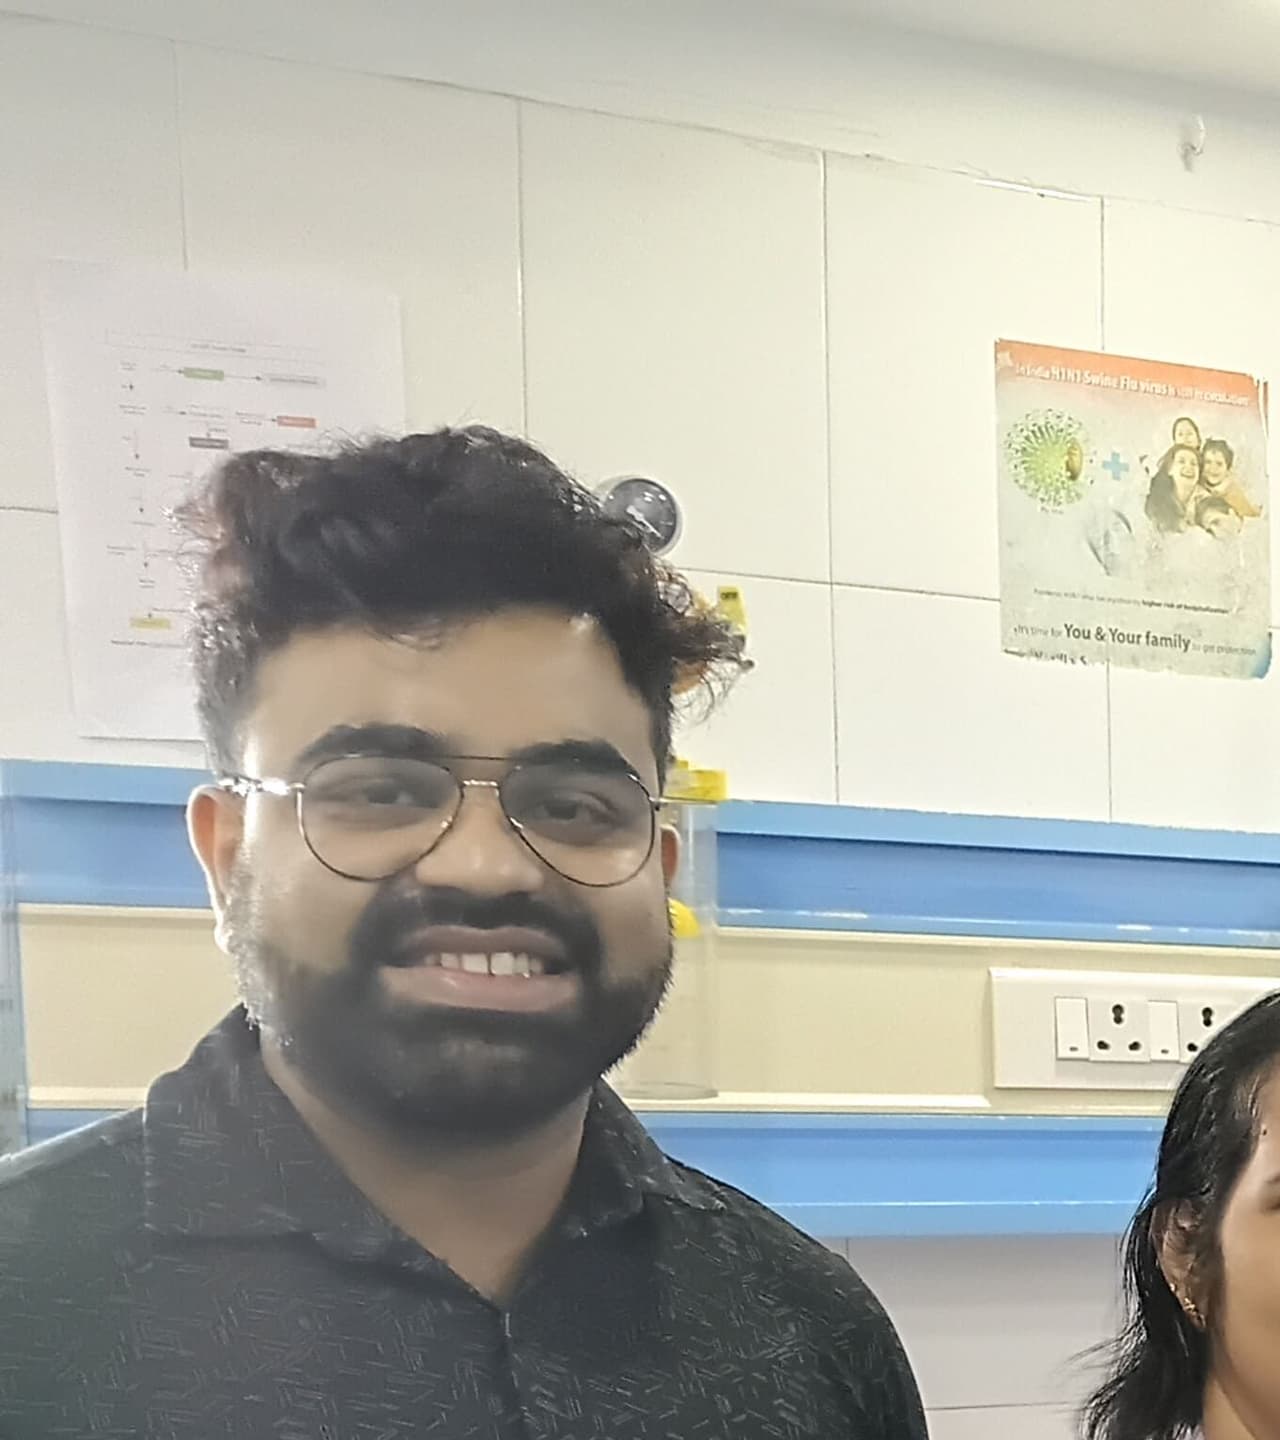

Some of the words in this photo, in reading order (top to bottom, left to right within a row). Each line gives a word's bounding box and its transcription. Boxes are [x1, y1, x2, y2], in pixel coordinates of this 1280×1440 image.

[1050, 365, 1082, 384] H1N1
[1083, 369, 1118, 389] Swine
[1119, 375, 1138, 392] Flu
[1139, 379, 1168, 397] virus
[1064, 623, 1092, 641] You
[1094, 625, 1107, 642] &
[1108, 627, 1143, 645] Your
[1145, 629, 1192, 654] family
